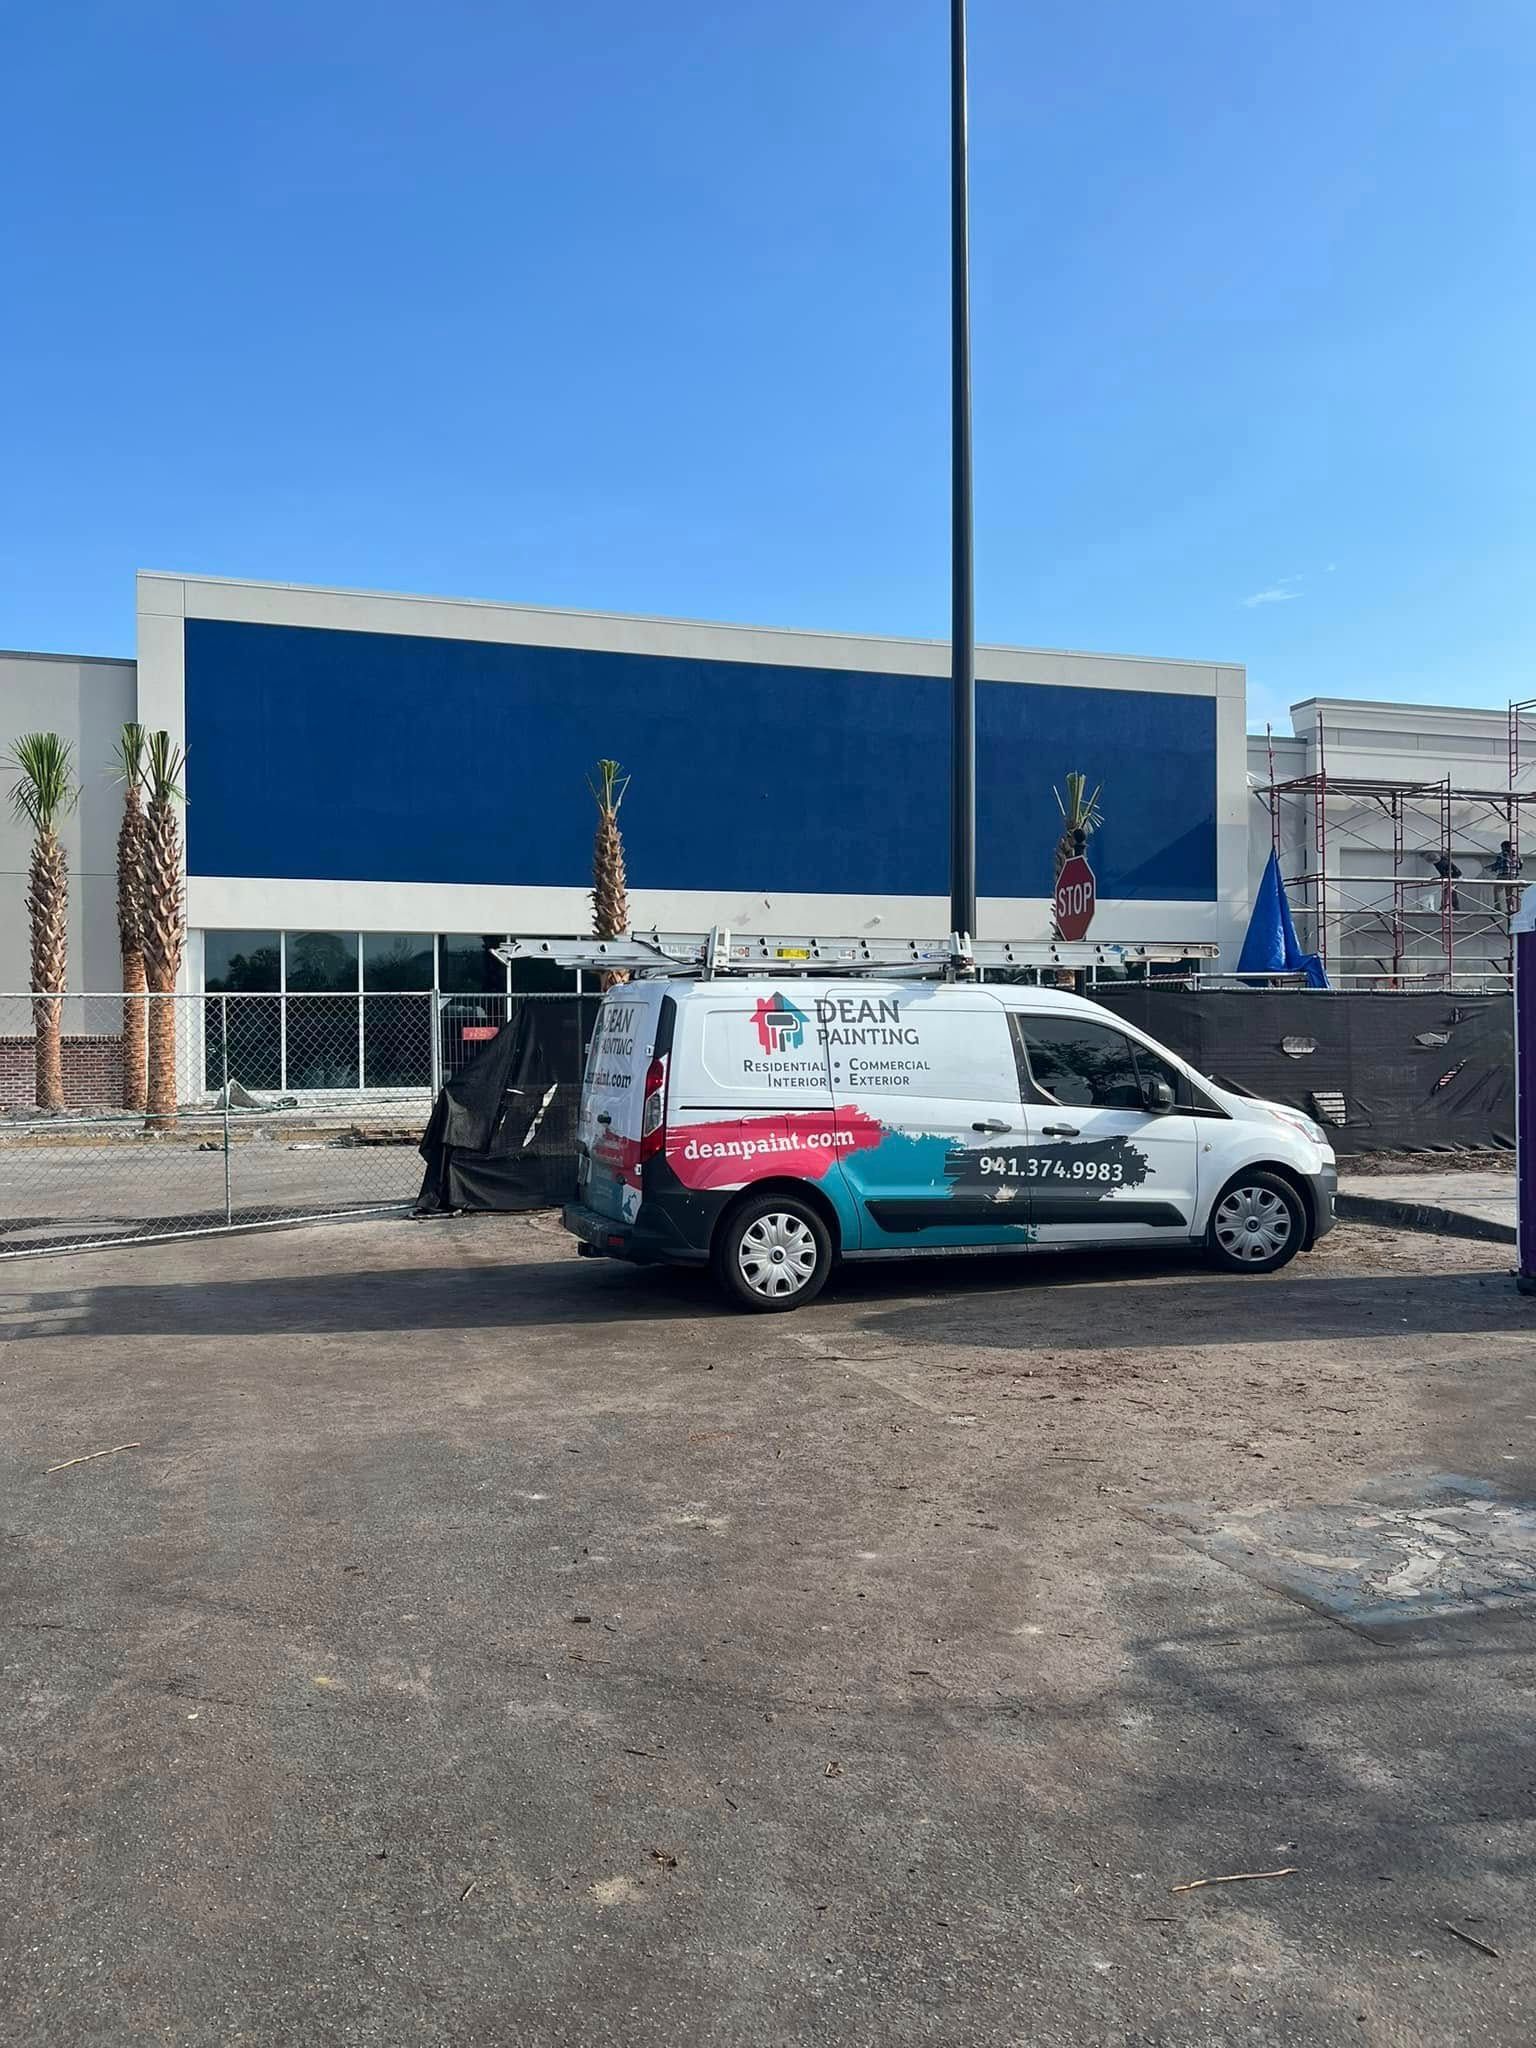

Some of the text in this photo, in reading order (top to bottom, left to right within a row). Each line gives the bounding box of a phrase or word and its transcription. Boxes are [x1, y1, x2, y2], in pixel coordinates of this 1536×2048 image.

[1058, 882, 1092, 917] STOP
[813, 999, 900, 1023] DEAN
[816, 1028, 920, 1046] PAINTING
[743, 1058, 931, 1073] RESIDENTIAL COMMERCIAL
[768, 1073, 910, 1087] INTERIOR EXTERIOR
[684, 1130, 855, 1160] deanpaint.com
[979, 1156, 1123, 1181] 941.374.9983
